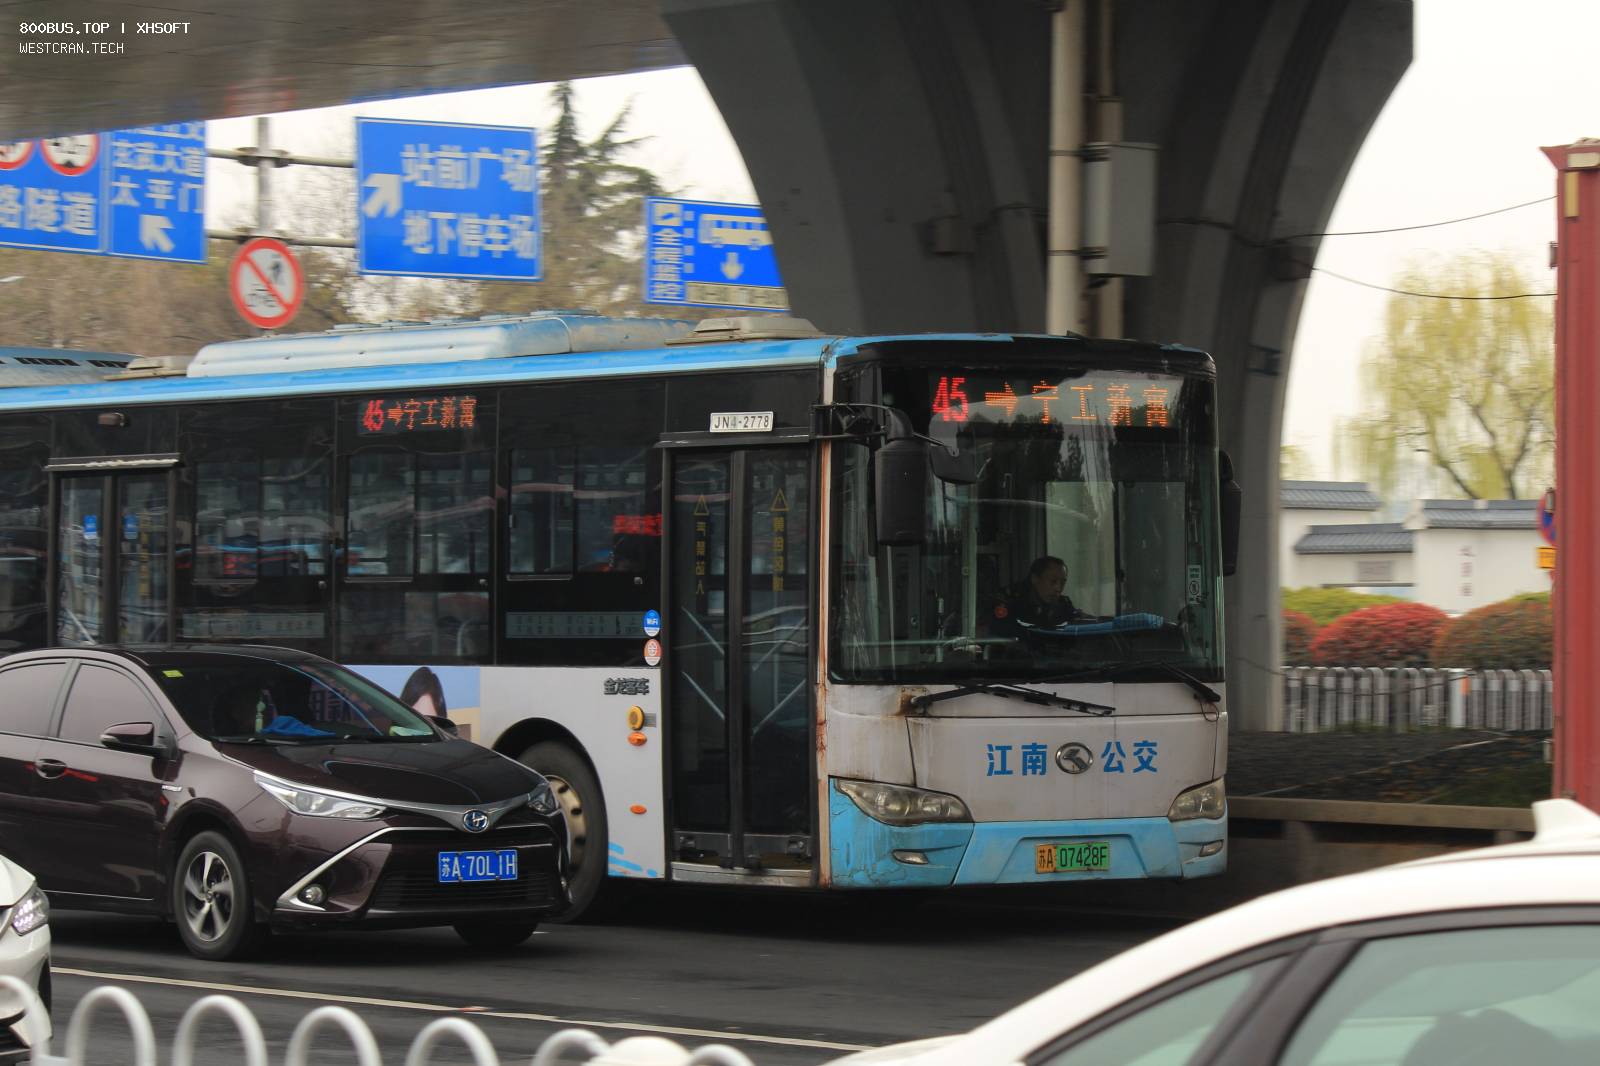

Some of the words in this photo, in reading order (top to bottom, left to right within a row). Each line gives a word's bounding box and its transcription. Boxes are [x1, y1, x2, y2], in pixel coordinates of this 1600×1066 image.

[111, 140, 205, 178] 玄武大道
[401, 143, 536, 193] 站前广场
[110, 175, 205, 214] 太平门
[402, 209, 537, 259] 地下停车场
[363, 399, 385, 432] 45
[932, 376, 968, 422] 45
[1032, 378, 1169, 427] 宁工新寓
[714, 415, 769, 428] JN4-2778
[603, 677, 650, 696] 金龙客车
[986, 742, 1048, 777] 江南
[1101, 740, 1158, 774] 公交
